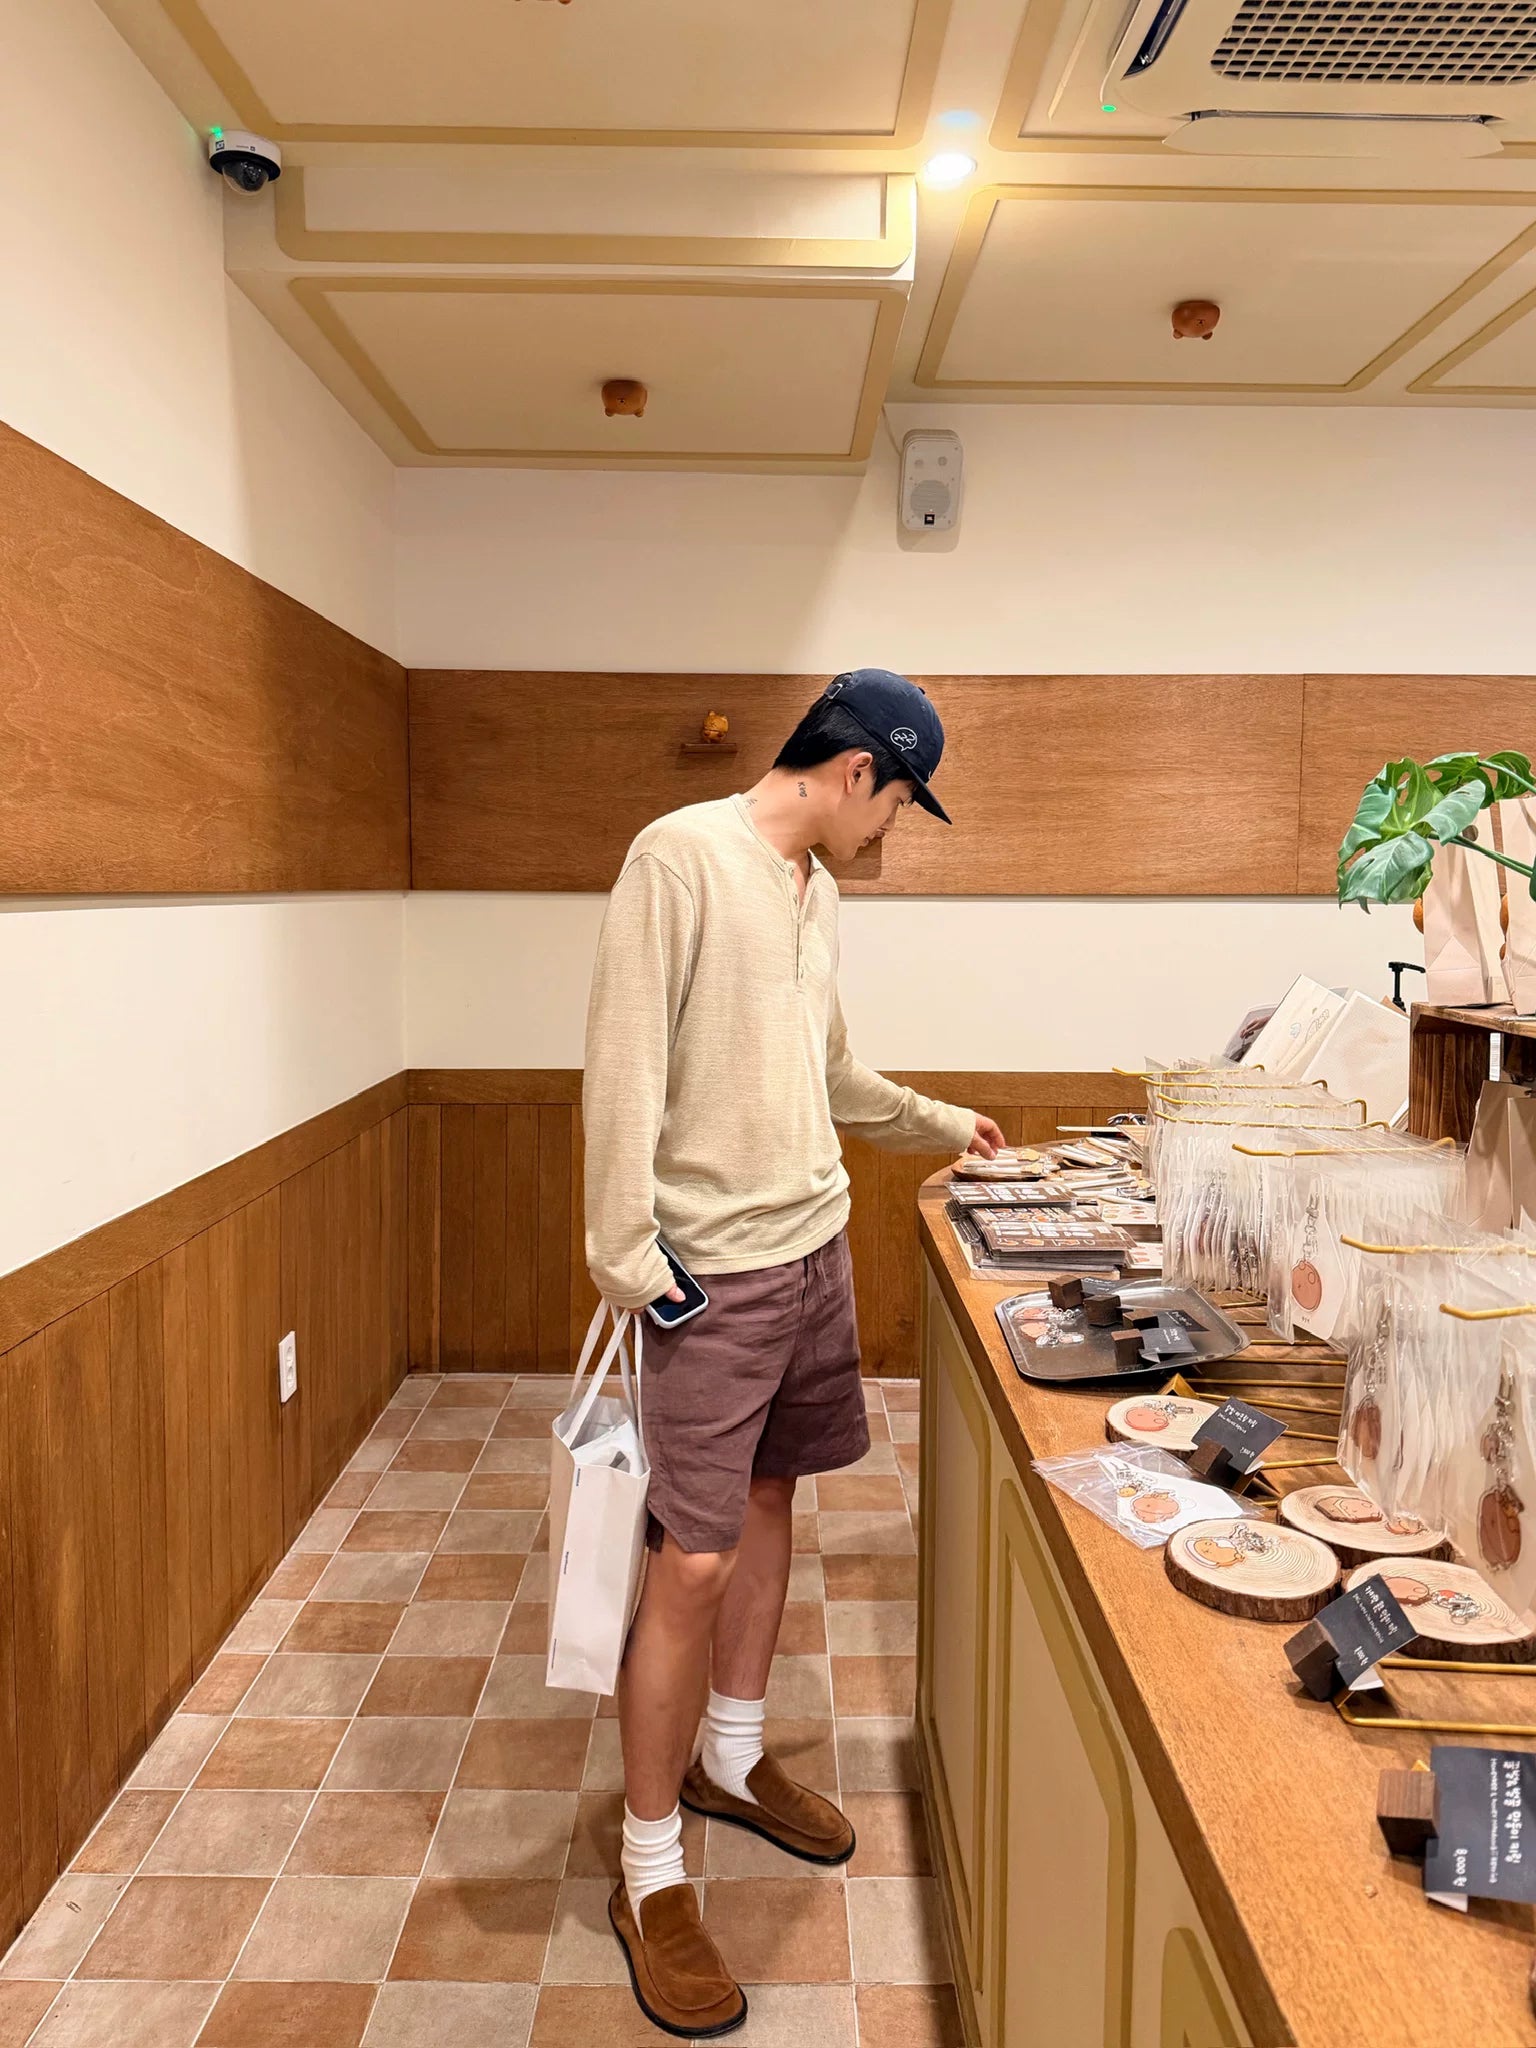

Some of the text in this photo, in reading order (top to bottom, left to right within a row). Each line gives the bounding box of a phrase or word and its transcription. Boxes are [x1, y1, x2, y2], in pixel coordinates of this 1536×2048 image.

[1504, 1811, 1522, 1839] 막둥이
[1504, 1842, 1522, 1863] 키링
[1452, 1848, 1468, 1887] 8,000 원
